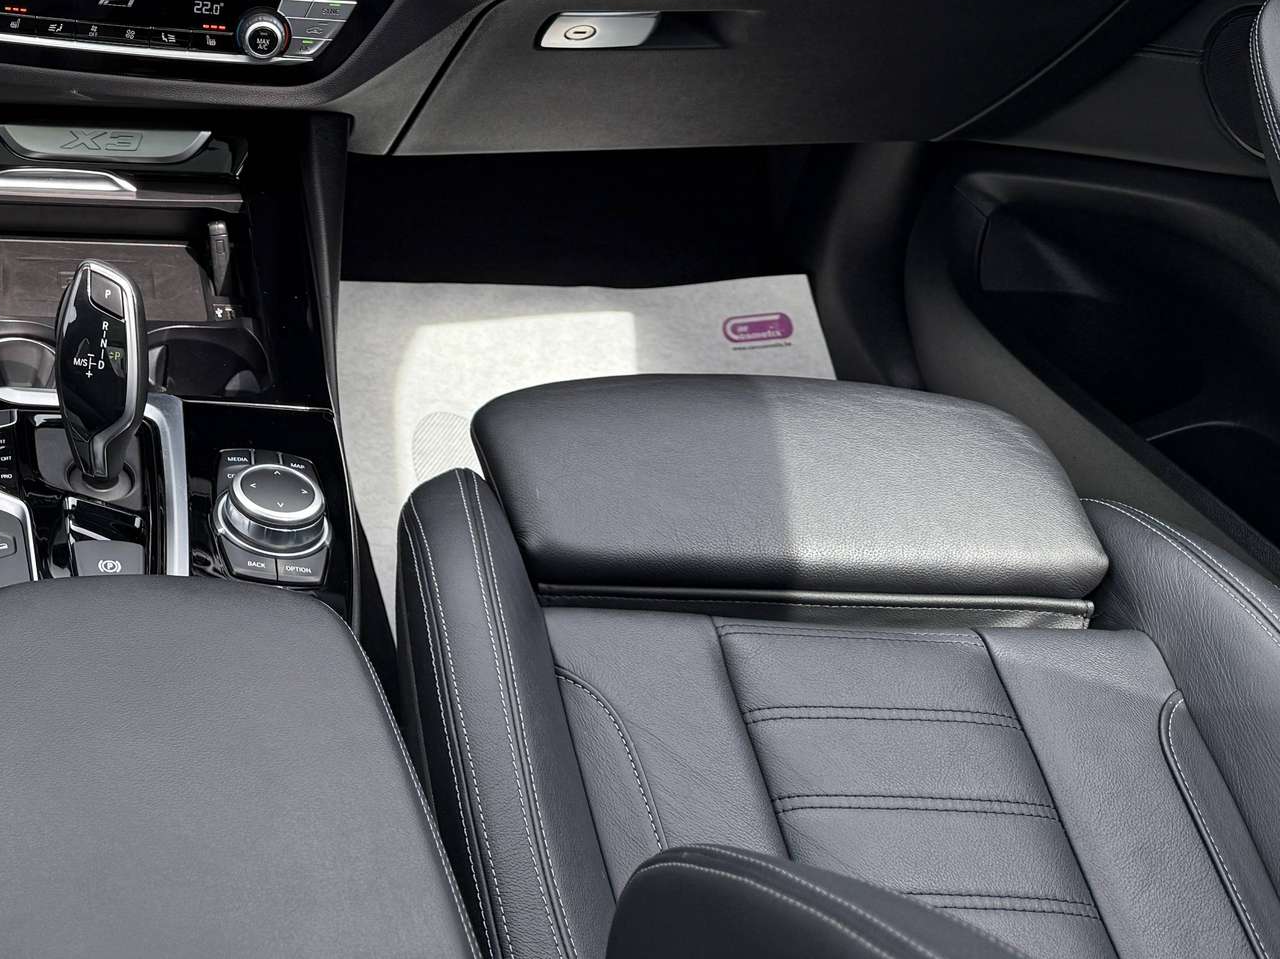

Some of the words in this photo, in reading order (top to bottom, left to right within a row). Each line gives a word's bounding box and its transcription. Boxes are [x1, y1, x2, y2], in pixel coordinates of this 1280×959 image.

[60, 130, 144, 152] X3
[104, 289, 111, 299] P
[102, 321, 109, 331] R
[100, 338, 108, 348] N
[73, 357, 89, 367] M/S
[97, 360, 105, 370] D
[247, 560, 266, 569] BACK
[285, 565, 312, 574] OPTION
